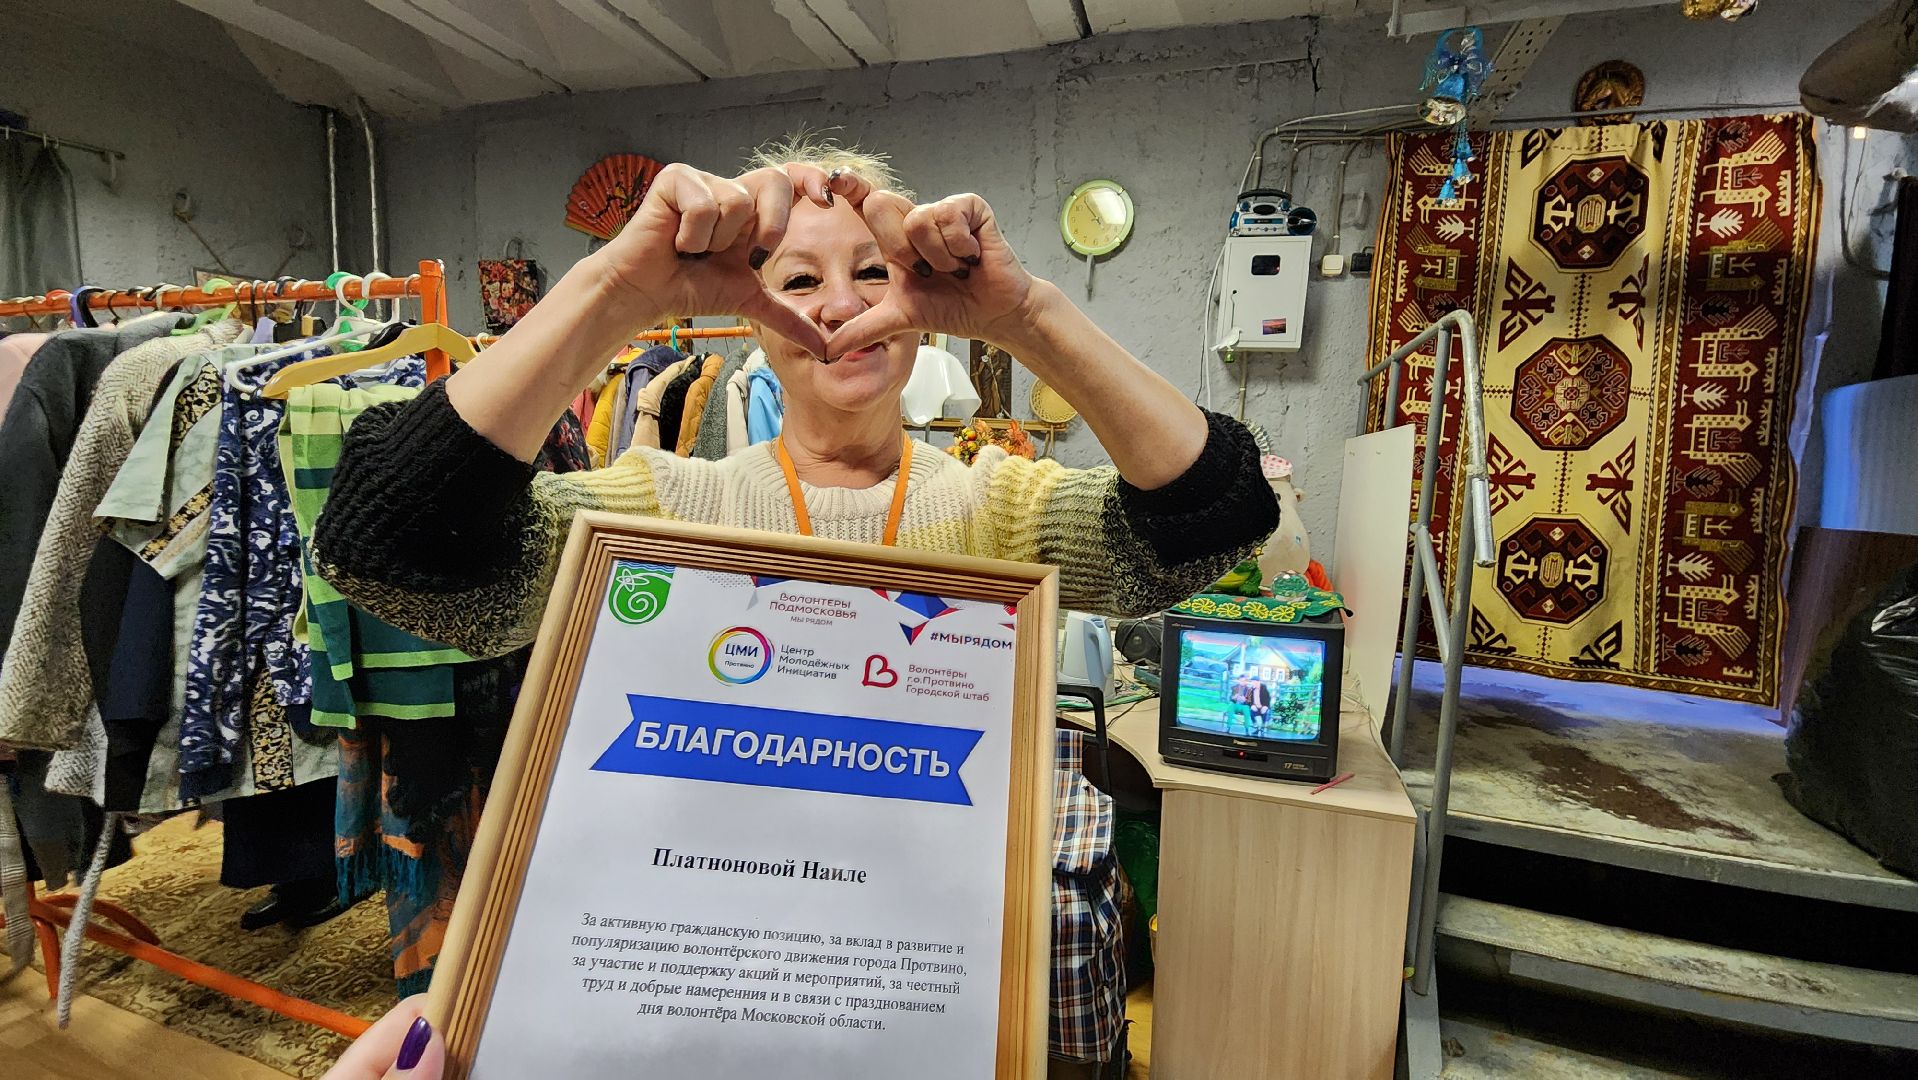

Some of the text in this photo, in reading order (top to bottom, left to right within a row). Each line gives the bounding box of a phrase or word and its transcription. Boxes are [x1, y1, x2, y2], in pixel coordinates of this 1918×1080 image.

[725, 643, 758, 657] ЦМИ
[781, 644, 815, 657] Центр
[930, 632, 1012, 650] #МЫРЯДОМ
[777, 665, 837, 679] Инициатив
[779, 655, 850, 670] Молодёжных
[908, 664, 967, 679] Волонтёры
[906, 684, 990, 702] Городской штаб
[634, 721, 950, 777] БЛАГОДАРНОСТЬ
[651, 848, 867, 883] Платноновой Наиле
[581, 912, 965, 954] За активную гражданскую позицию, за вклад в развитие и
[571, 935, 967, 976] популяризацию волонтёрского движения города Протвино,
[572, 956, 961, 994] за участие и поддержку акций и мероприятий, за честный
[582, 977, 945, 1014] труд и добрые намеренния и в связи с празднованием
[637, 1003, 886, 1031] дня волонтёра Московской области.
